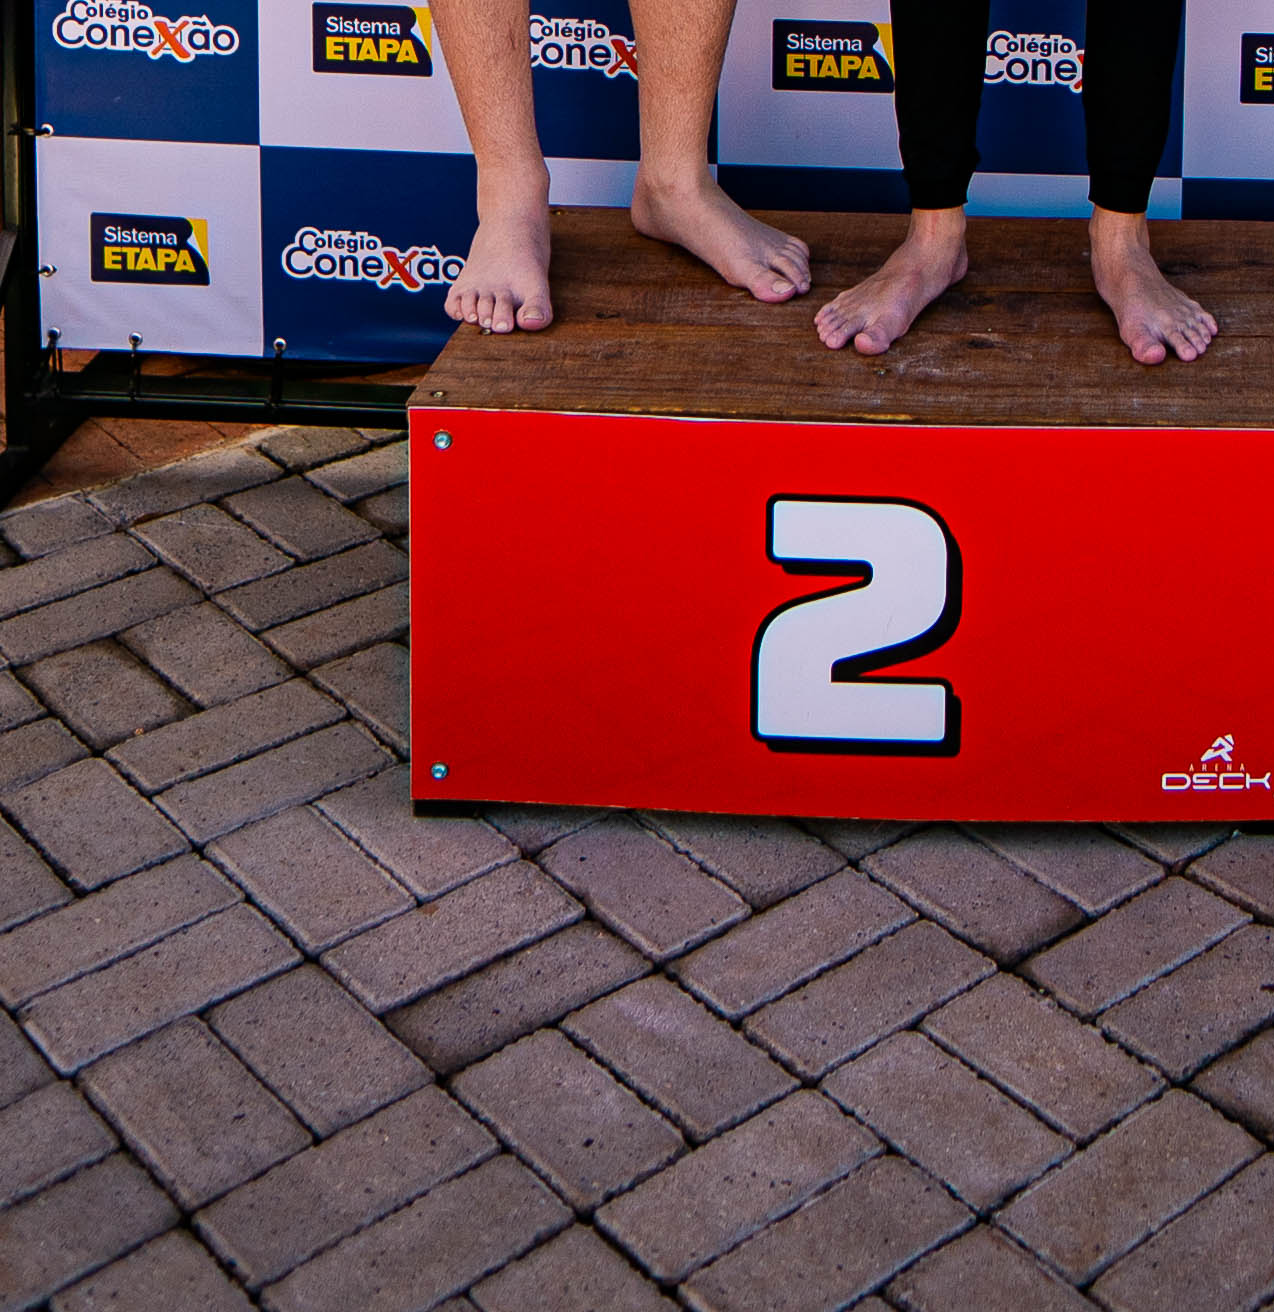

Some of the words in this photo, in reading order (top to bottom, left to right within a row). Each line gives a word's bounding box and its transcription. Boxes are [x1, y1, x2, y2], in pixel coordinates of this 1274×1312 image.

[326, 16, 400, 35] Sistema
[325, 36, 418, 64] ETAPA
[787, 33, 862, 52] Sistema
[991, 34, 1072, 57] Colégio
[786, 55, 880, 80] ETAPA
[104, 226, 177, 246] Sistema
[299, 231, 378, 255] Colégio
[103, 247, 196, 274] ETAPA
[752, 494, 957, 751] 2
[1162, 772, 1271, 791] DECK
